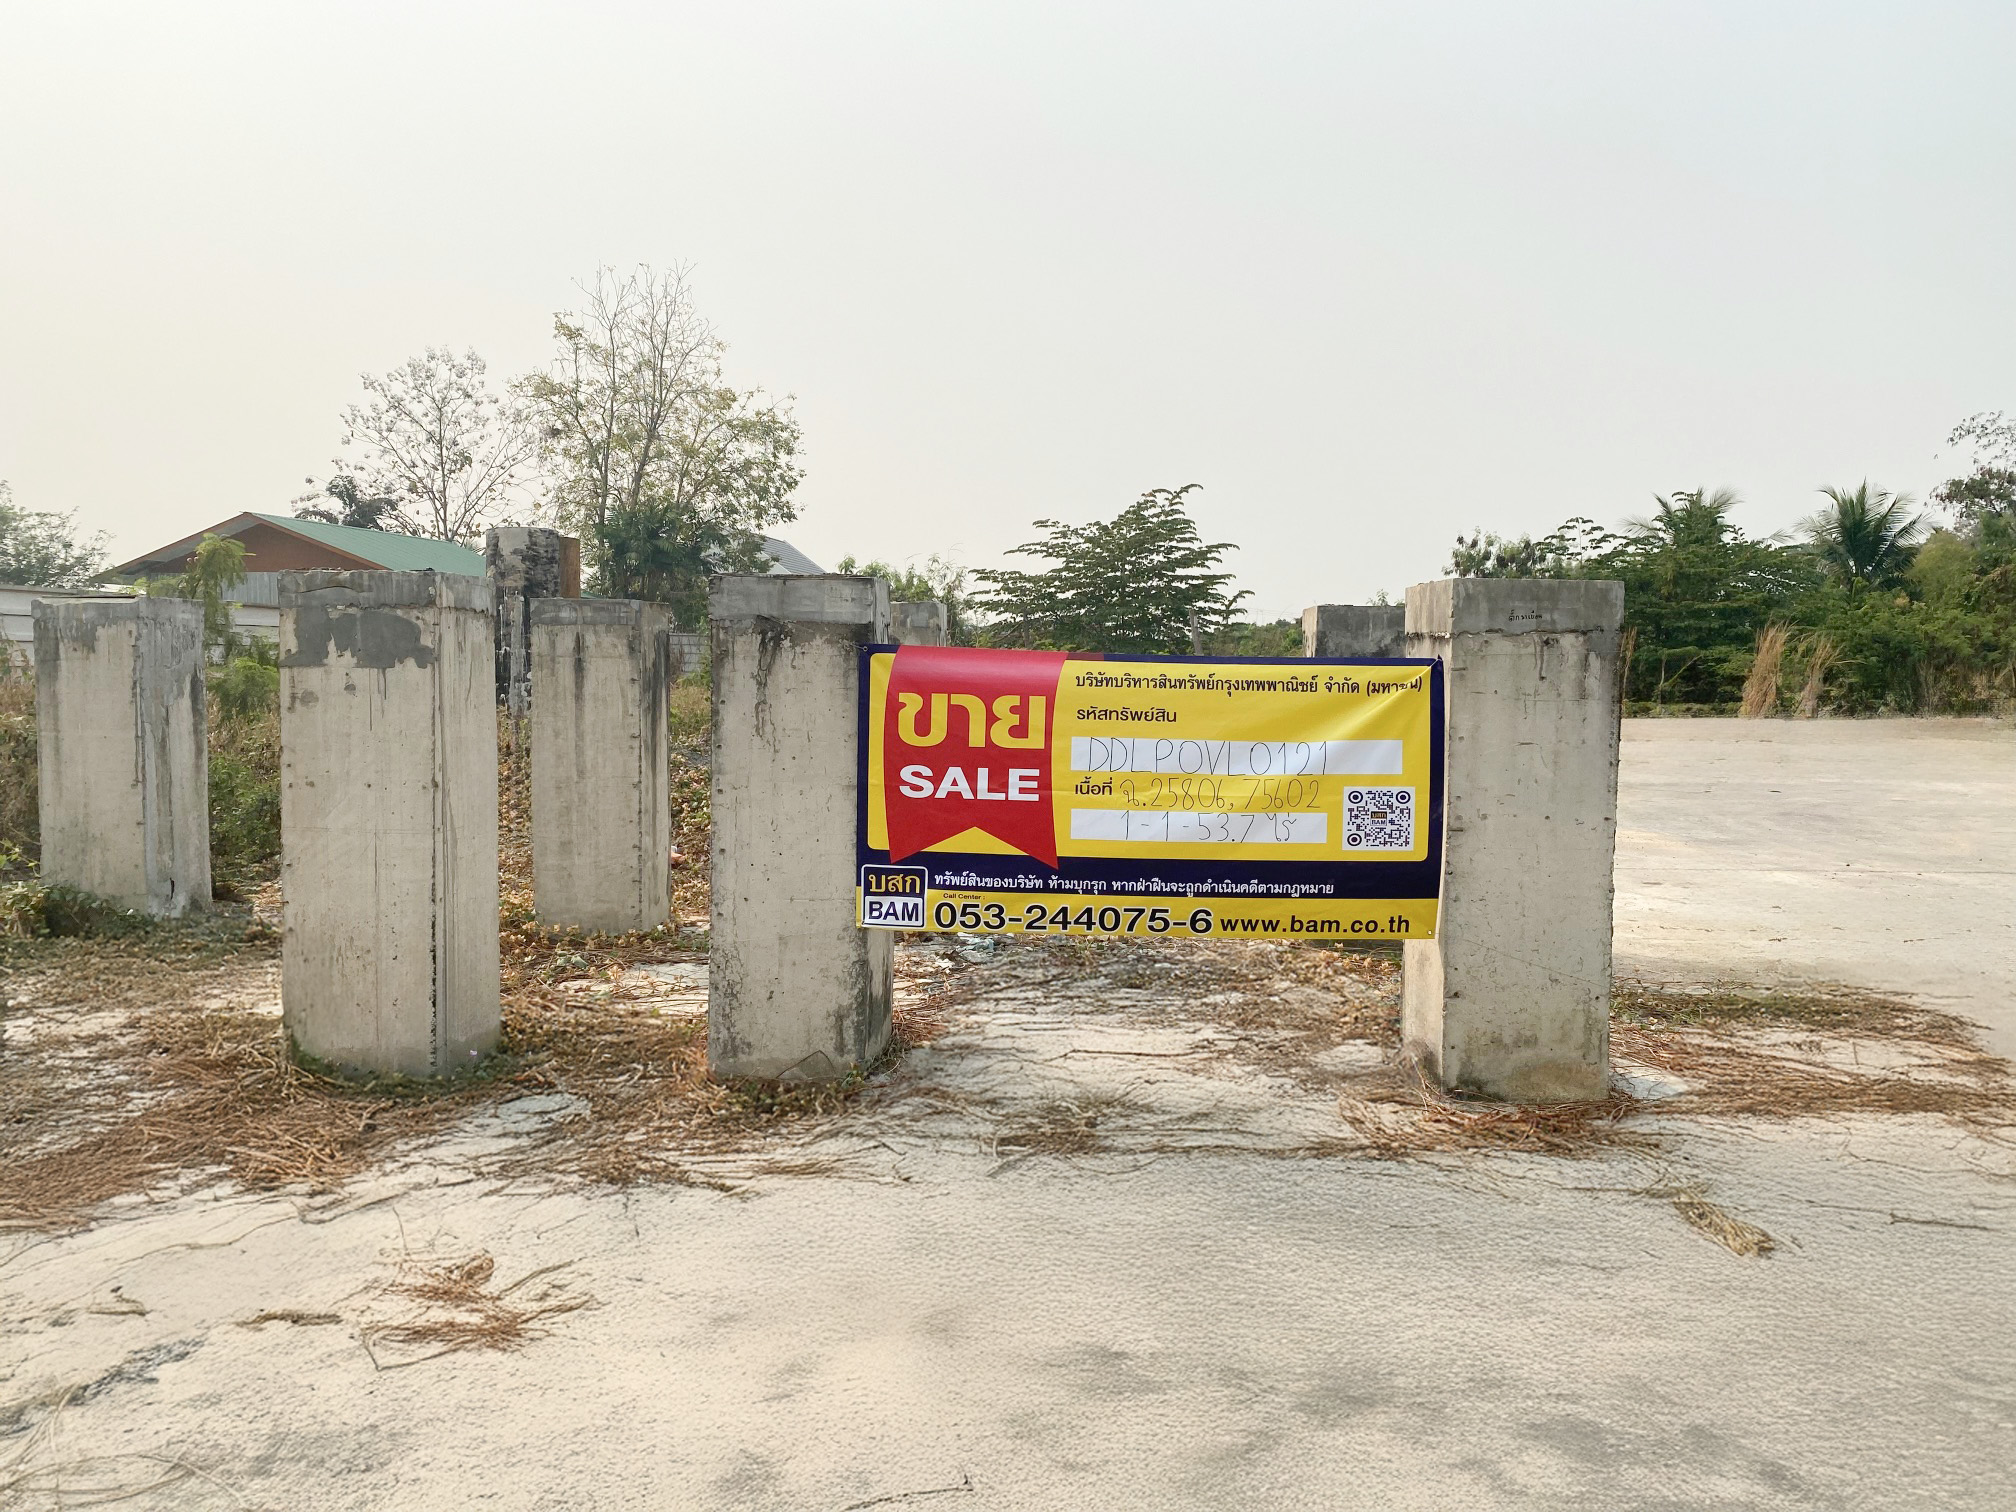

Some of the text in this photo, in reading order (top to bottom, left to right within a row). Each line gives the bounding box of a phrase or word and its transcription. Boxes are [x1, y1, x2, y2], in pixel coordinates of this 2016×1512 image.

[1075, 672, 1318, 697] บริษัทบริหารสินทรัพย์กรุงเทพพาณิชย์
[1324, 675, 1360, 694] จำกัด
[898, 692, 1046, 749] ขาย
[1076, 706, 1178, 723] รหัสทรัพย์สิน
[899, 764, 1040, 801] SALE
[1074, 776, 1113, 796] เนื้อที่
[868, 873, 921, 893] บสก
[934, 871, 1334, 897] ทรัพย์สินของบริษัท ห้ามบุกรุก หากฝ่าฝืนจะถูกดำเนินคดีตามกฎหมาย
[868, 901, 920, 922] BAM
[934, 902, 1411, 934] 053-244075-6 www.bam.co.th
